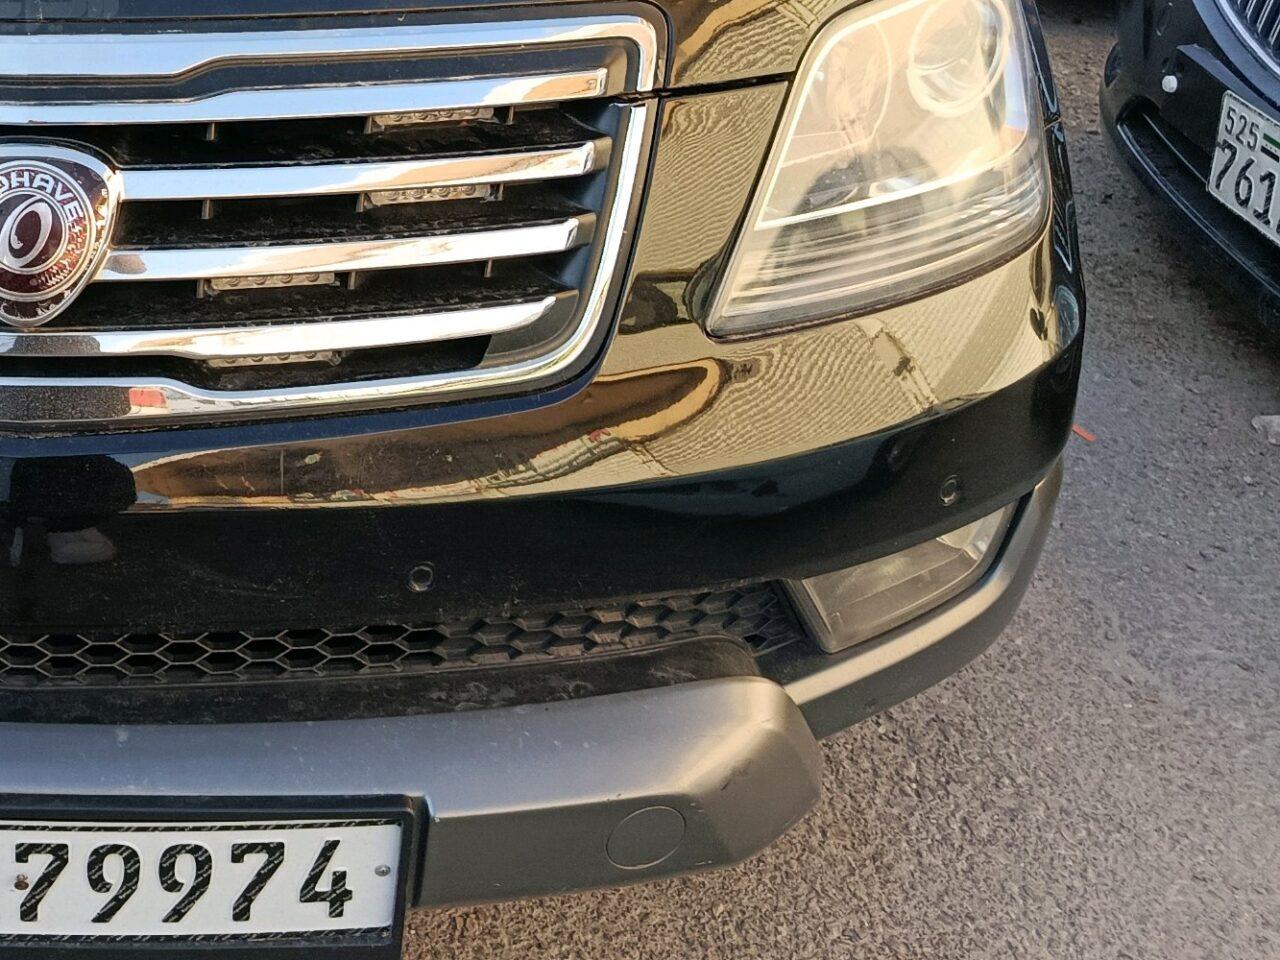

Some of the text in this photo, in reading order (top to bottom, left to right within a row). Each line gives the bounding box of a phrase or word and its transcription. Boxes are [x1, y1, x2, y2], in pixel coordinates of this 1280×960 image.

[1224, 106, 1260, 151] 525
[1216, 138, 1280, 234] 761
[13, 839, 355, 924] 79974
